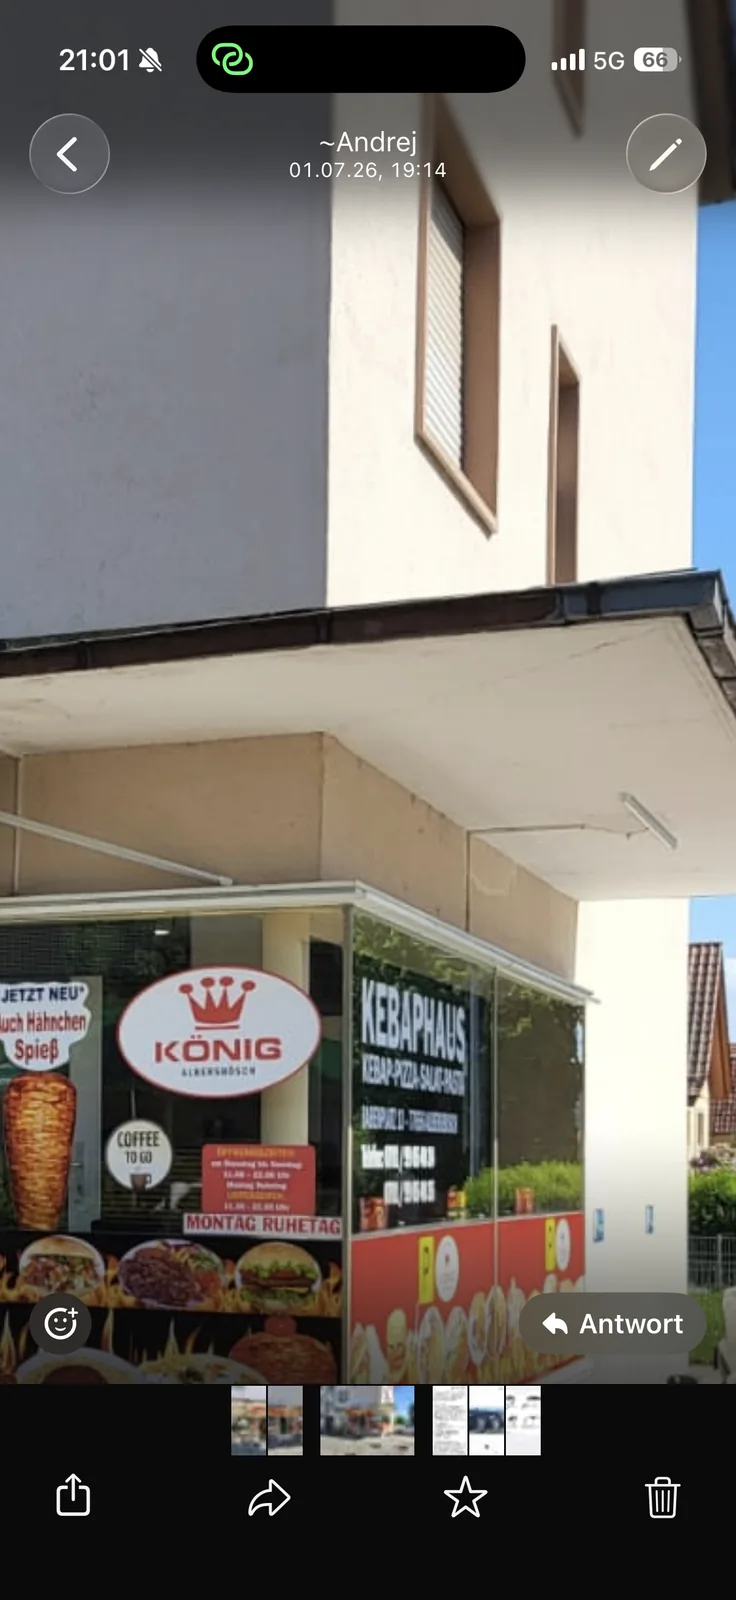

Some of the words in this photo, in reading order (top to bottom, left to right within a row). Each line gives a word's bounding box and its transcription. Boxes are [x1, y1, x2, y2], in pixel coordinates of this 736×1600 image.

[2, 987, 45, 1003] JETZT
[0, 1012, 24, 1033] uch
[27, 1010, 86, 1033] Hähnchen
[362, 977, 466, 1064] KEBAPHAUS
[15, 1038, 58, 1065] Spieß
[155, 1035, 282, 1063] KÖNIG
[117, 1130, 161, 1148] COFFEE
[125, 1151, 137, 1164] TO
[140, 1151, 152, 1164] GO
[187, 1214, 257, 1232] MONTAG
[262, 1216, 341, 1235] RUHETAG
